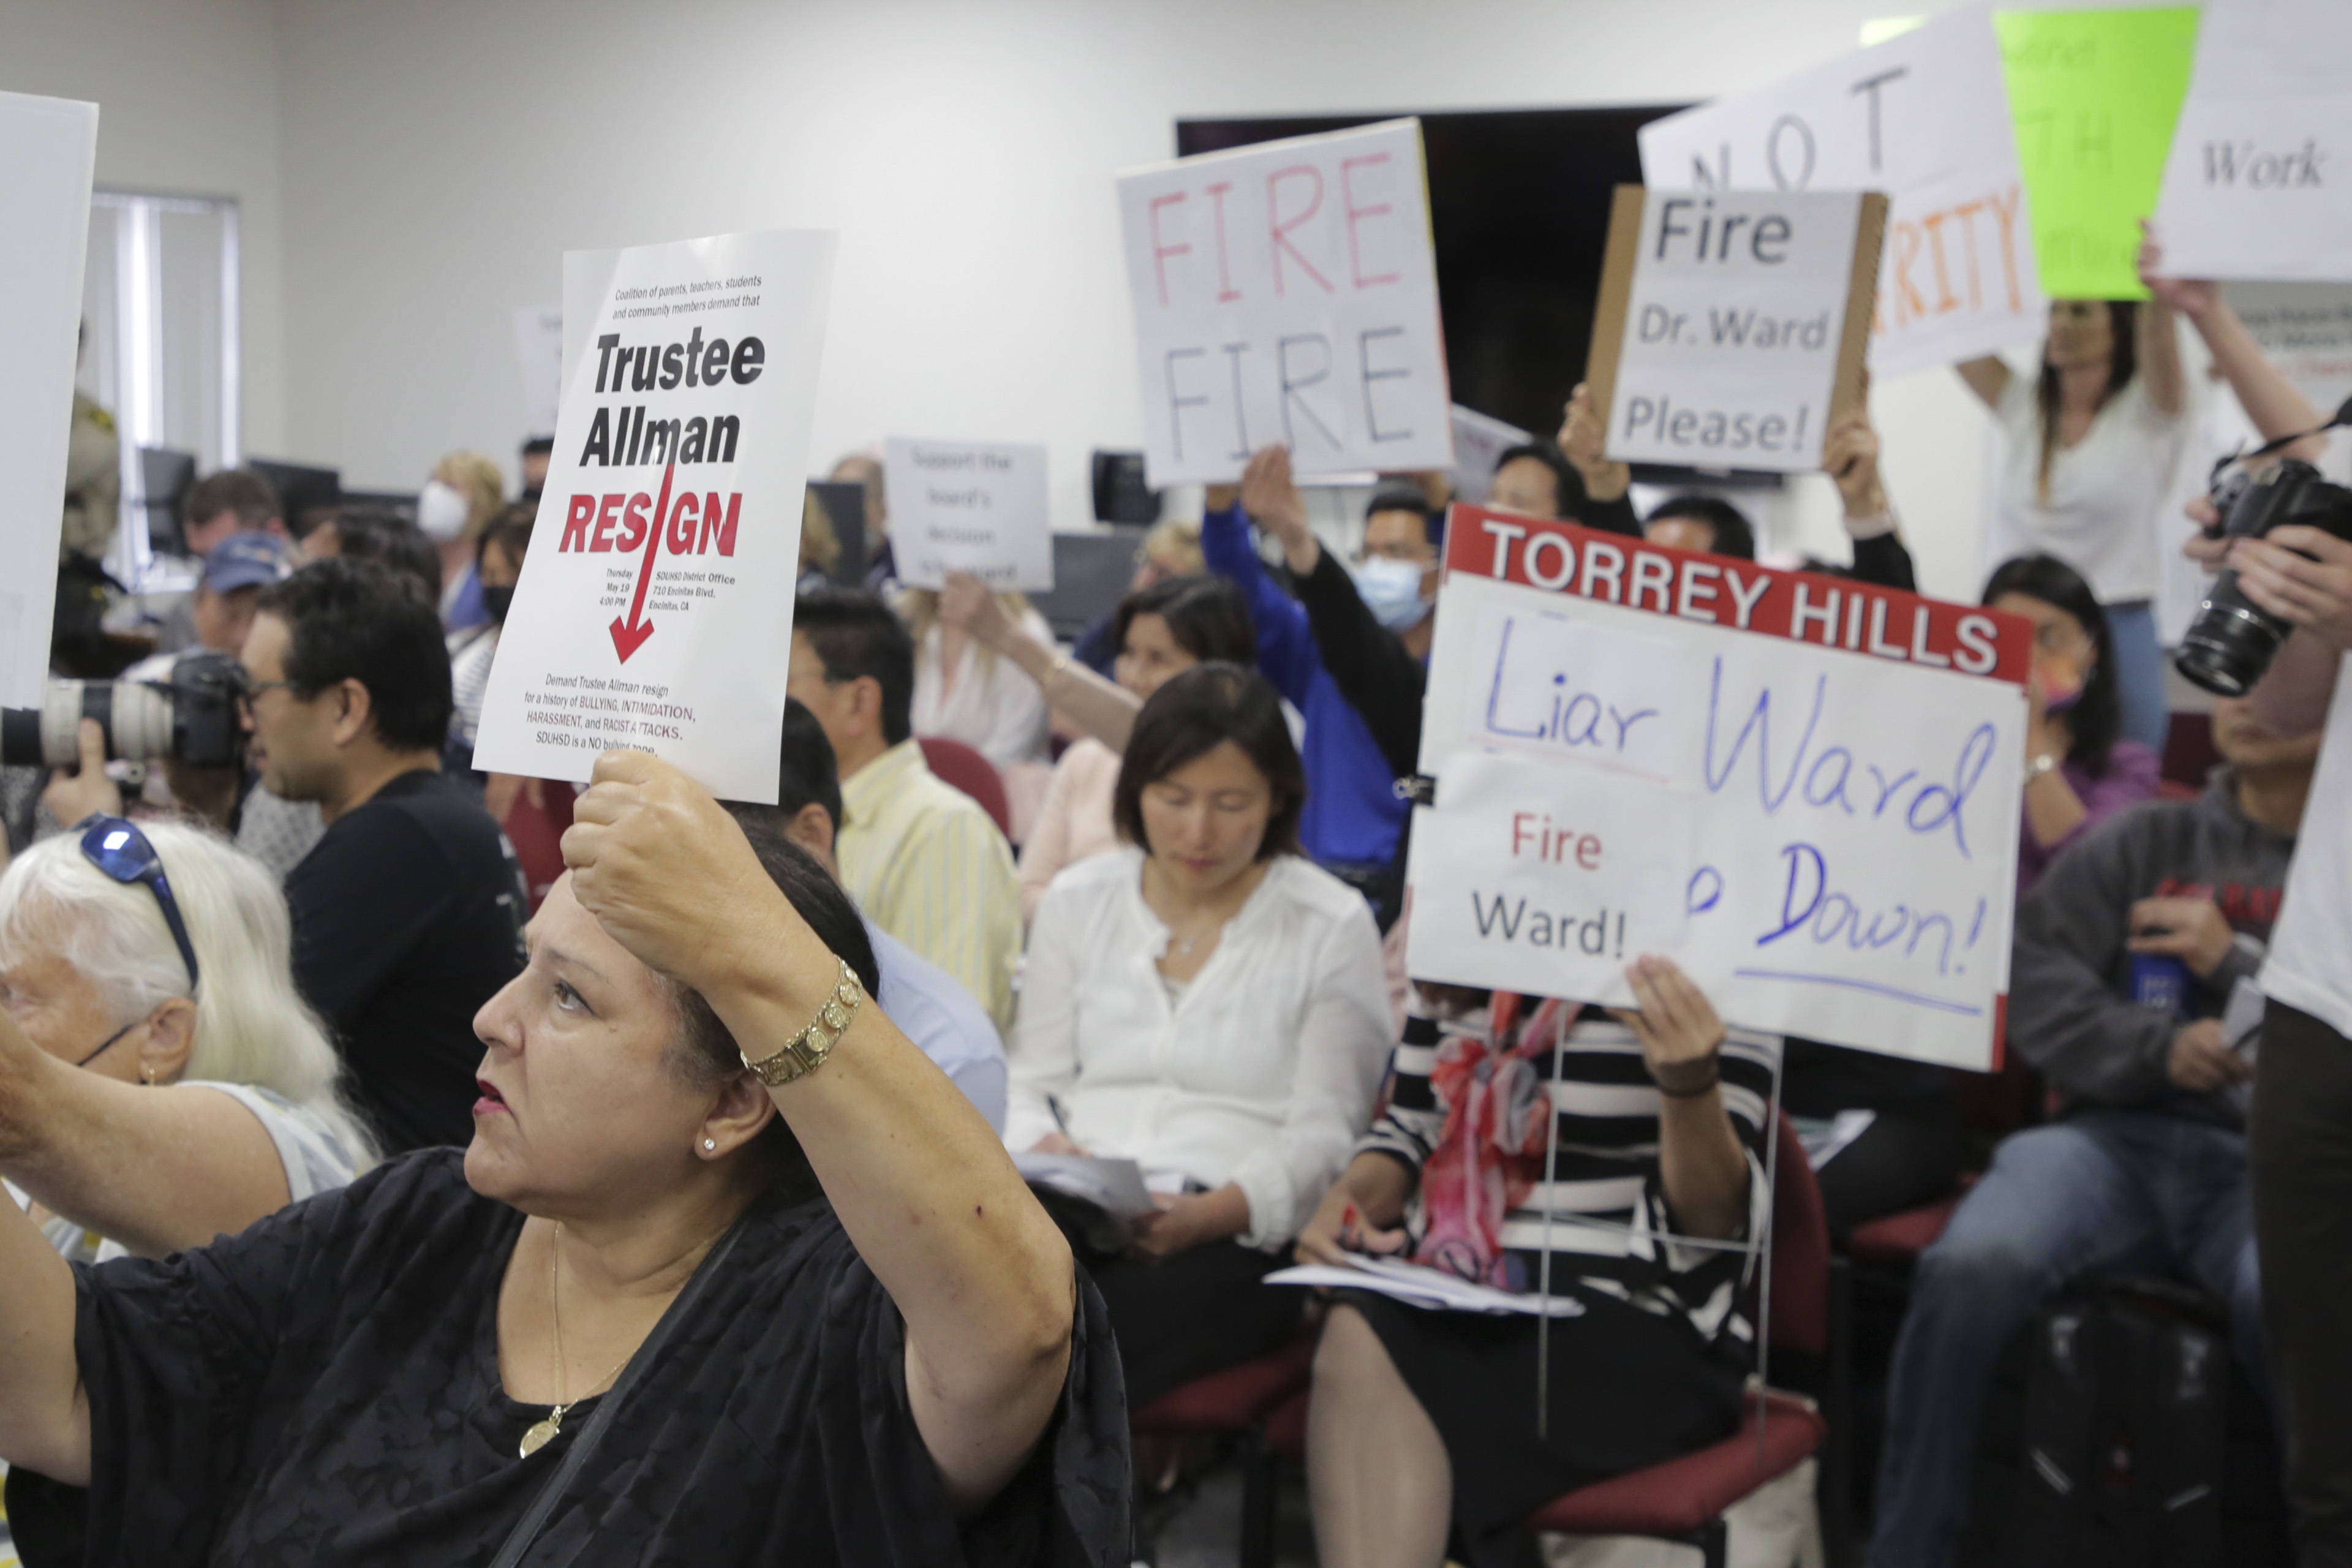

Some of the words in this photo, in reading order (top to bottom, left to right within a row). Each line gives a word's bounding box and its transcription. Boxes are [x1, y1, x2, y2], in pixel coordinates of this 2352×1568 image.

[1692, 65, 1910, 191] NOT
[2204, 136, 2329, 190] Work
[1150, 152, 1401, 306] FIRE
[1656, 199, 1792, 265] Fire
[1872, 184, 2022, 335] RITY
[612, 307, 627, 320] and
[628, 303, 671, 318] community
[672, 300, 706, 315] members
[707, 295, 741, 310] demand
[742, 294, 761, 307] that
[615, 287, 647, 301] Coalition
[649, 285, 658, 298] of
[658, 283, 688, 300] parents,
[690, 279, 723, 294] teachers,
[725, 275, 762, 289] students
[1638, 303, 1697, 345] Dr.
[1709, 308, 1831, 351] Ward
[595, 326, 765, 394] Trustee
[1166, 326, 1415, 463] FIRE
[579, 405, 741, 467] Allman
[1623, 396, 1811, 453] Please!
[606, 568, 633, 581] Thursday
[606, 582, 619, 594] May
[620, 583, 630, 593] 19
[653, 585, 666, 595] 710
[667, 586, 694, 597] Encinitas
[695, 587, 716, 598] Blvd.
[655, 571, 680, 581] SDUHSD
[682, 571, 706, 582] District
[708, 573, 736, 585] Office
[1482, 520, 1771, 630] TORREY
[1791, 582, 1999, 676] HILLS
[600, 597, 614, 606] 4:00
[614, 598, 626, 607] PM
[649, 600, 679, 611] Encinitas,
[680, 601, 690, 611] CA
[524, 691, 535, 704] for
[536, 694, 542, 704] a
[543, 693, 568, 710] history
[570, 695, 579, 707] of
[579, 696, 619, 714] BULLYING,
[622, 699, 696, 723] INTIMIDATION,
[545, 673, 578, 688] Demand
[579, 676, 606, 690] Trustee
[608, 679, 639, 693] Allman
[641, 683, 669, 699] resign
[527, 710, 582, 729] HARASSMENT,
[585, 718, 601, 730] and
[603, 718, 630, 733] RACIST
[536, 731, 570, 747] SDUHSD
[571, 736, 579, 748] is
[581, 738, 586, 748] a
[588, 737, 601, 750] NO
[1485, 616, 1660, 752] Liar
[1703, 654, 1998, 862] Ward
[1512, 812, 1602, 870] Fire
[1471, 891, 1626, 960] Ward!
[1755, 843, 1986, 974] Down!
